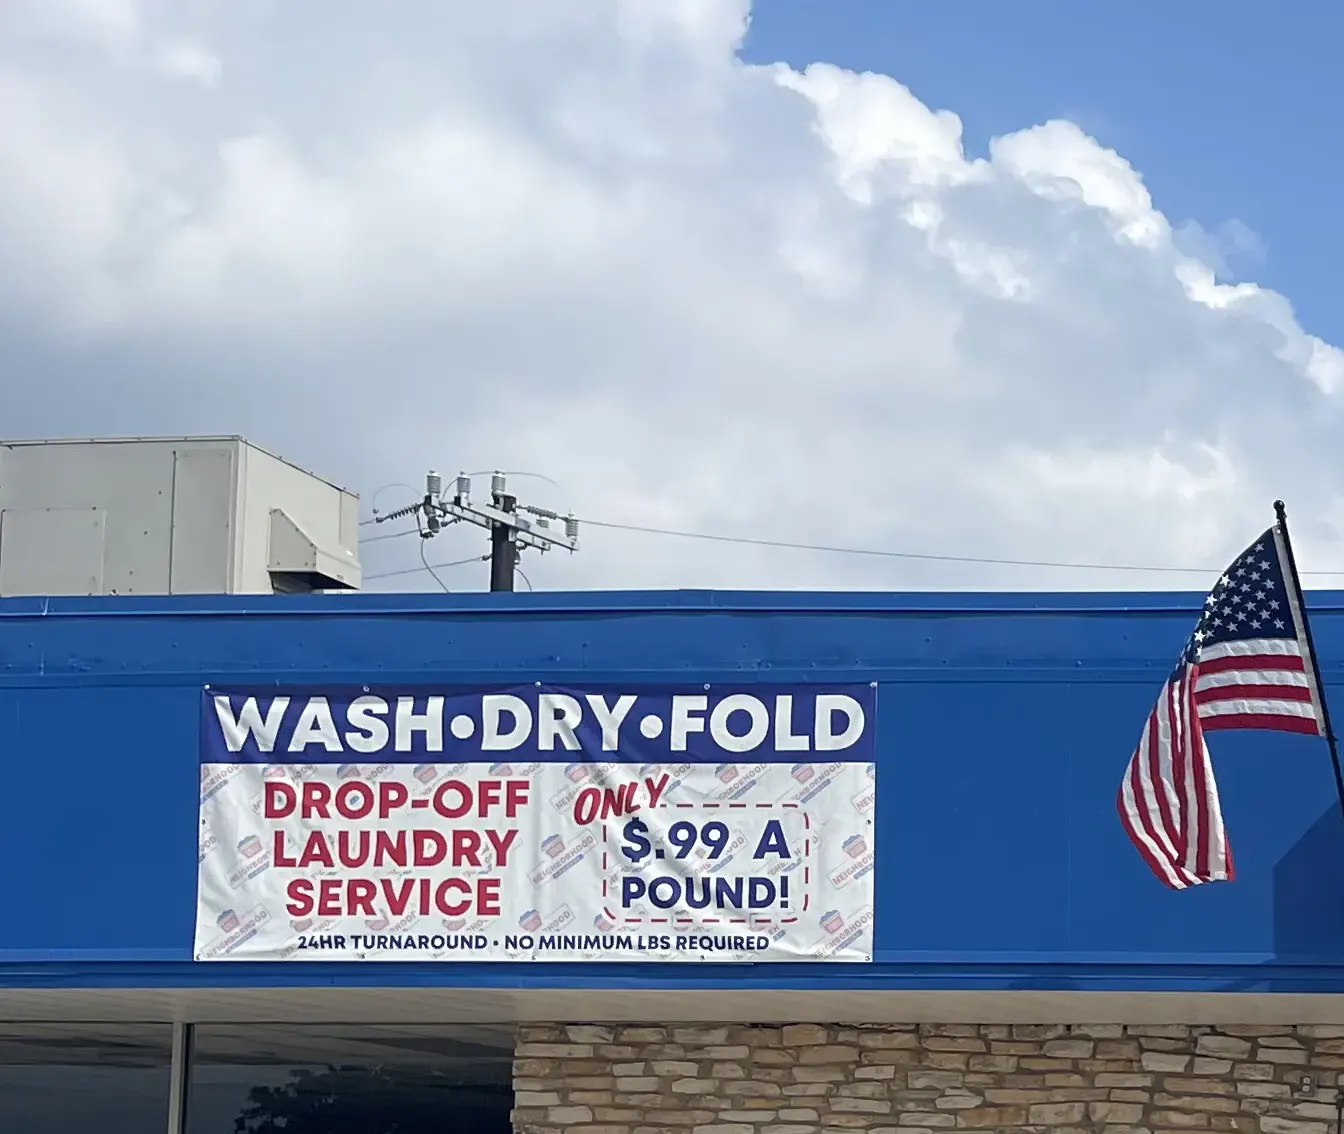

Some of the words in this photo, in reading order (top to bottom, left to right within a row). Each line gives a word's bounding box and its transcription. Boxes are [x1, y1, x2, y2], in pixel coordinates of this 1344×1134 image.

[264, 780, 529, 819] DROP-OFF
[574, 773, 669, 826] ONLY
[274, 830, 519, 868] LAUNDRY
[621, 816, 729, 863] $.99
[753, 819, 791, 859] A
[286, 877, 501, 917] SERVICE
[622, 875, 789, 909] POUND!
[297, 935, 346, 950] 24HR
[350, 935, 488, 950] TURNAROUND
[504, 935, 534, 950] NO
[538, 935, 633, 950] MINIMUM
[637, 935, 671, 950] LBS
[675, 935, 769, 952] REQUIRED
